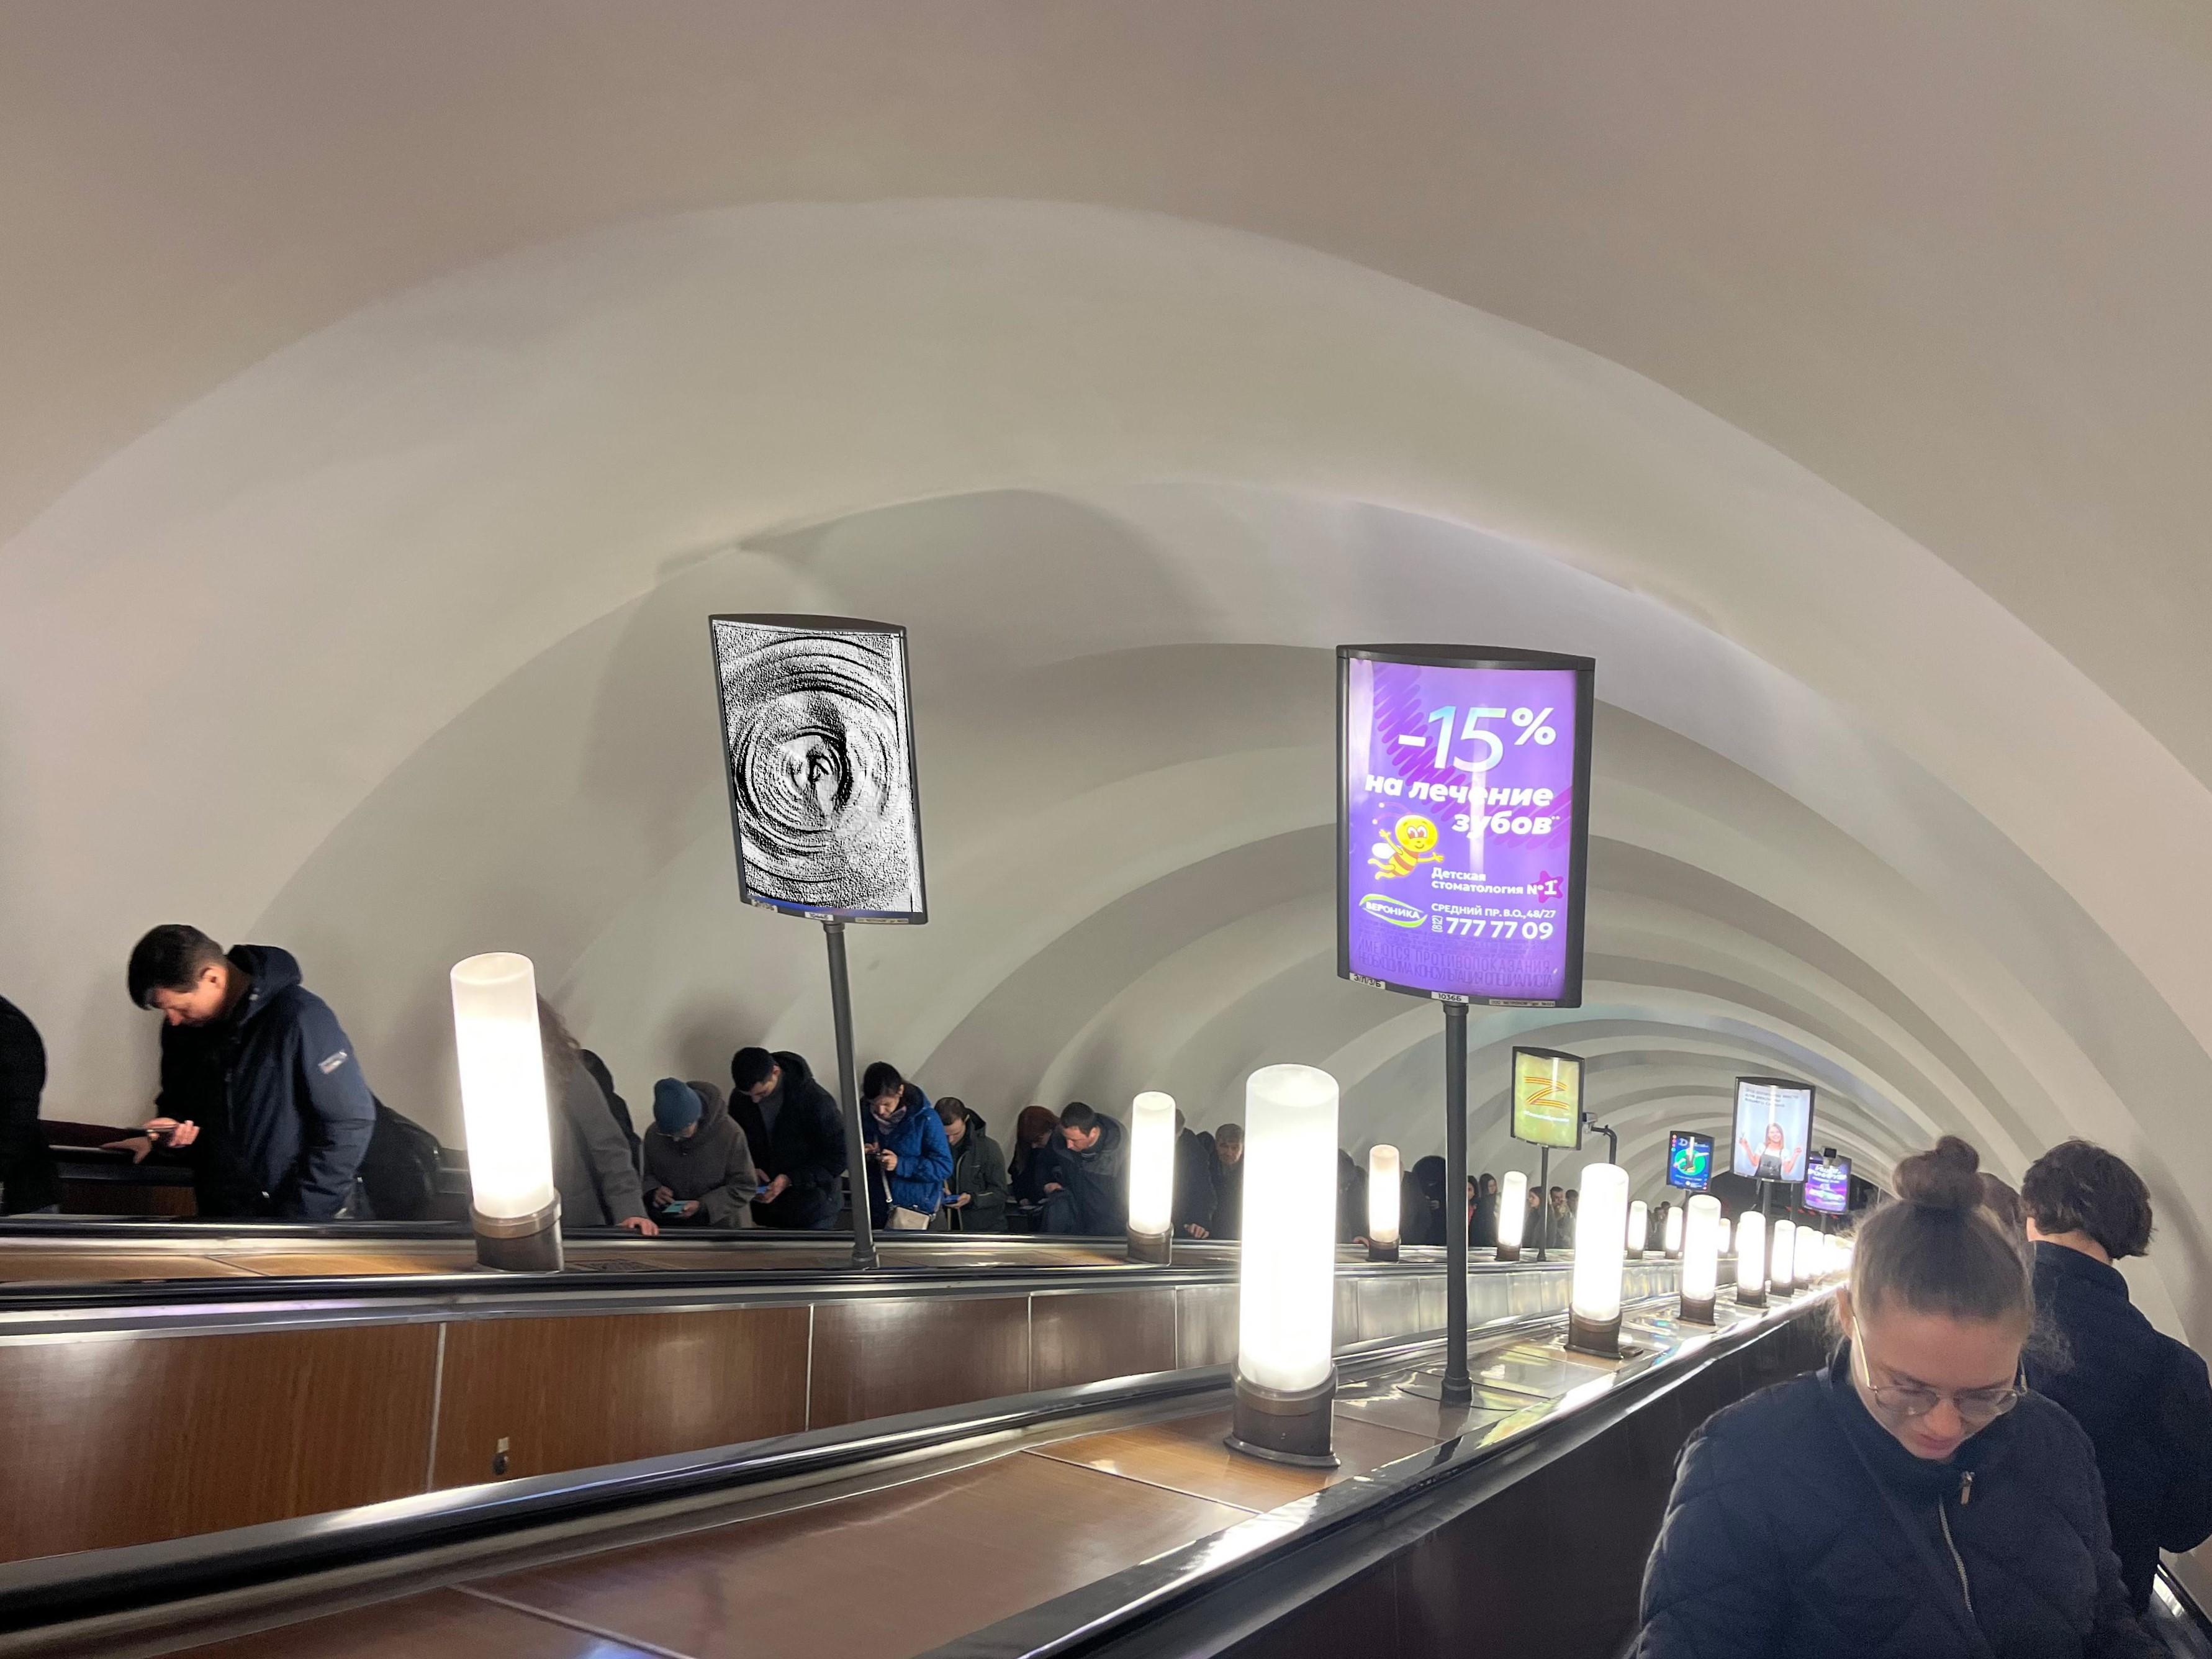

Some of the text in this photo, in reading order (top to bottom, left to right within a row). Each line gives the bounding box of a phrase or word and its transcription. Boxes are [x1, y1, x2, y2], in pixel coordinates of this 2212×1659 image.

[1398, 705, 1556, 772] -15%
[1365, 774, 1554, 807] на лечение
[1431, 867, 1486, 881] Детская
[1431, 880, 1524, 894] стоматология
[1366, 902, 1420, 919] ВЕРОНИКА
[1431, 903, 1483, 915] СРЕДНИЙ
[1431, 915, 1443, 933] (812)
[1445, 916, 1486, 936] 777
[1491, 920, 1519, 938] 77
[1522, 921, 1553, 940] 09
[1358, 938, 1410, 962] ИМЕЮТСЯ
